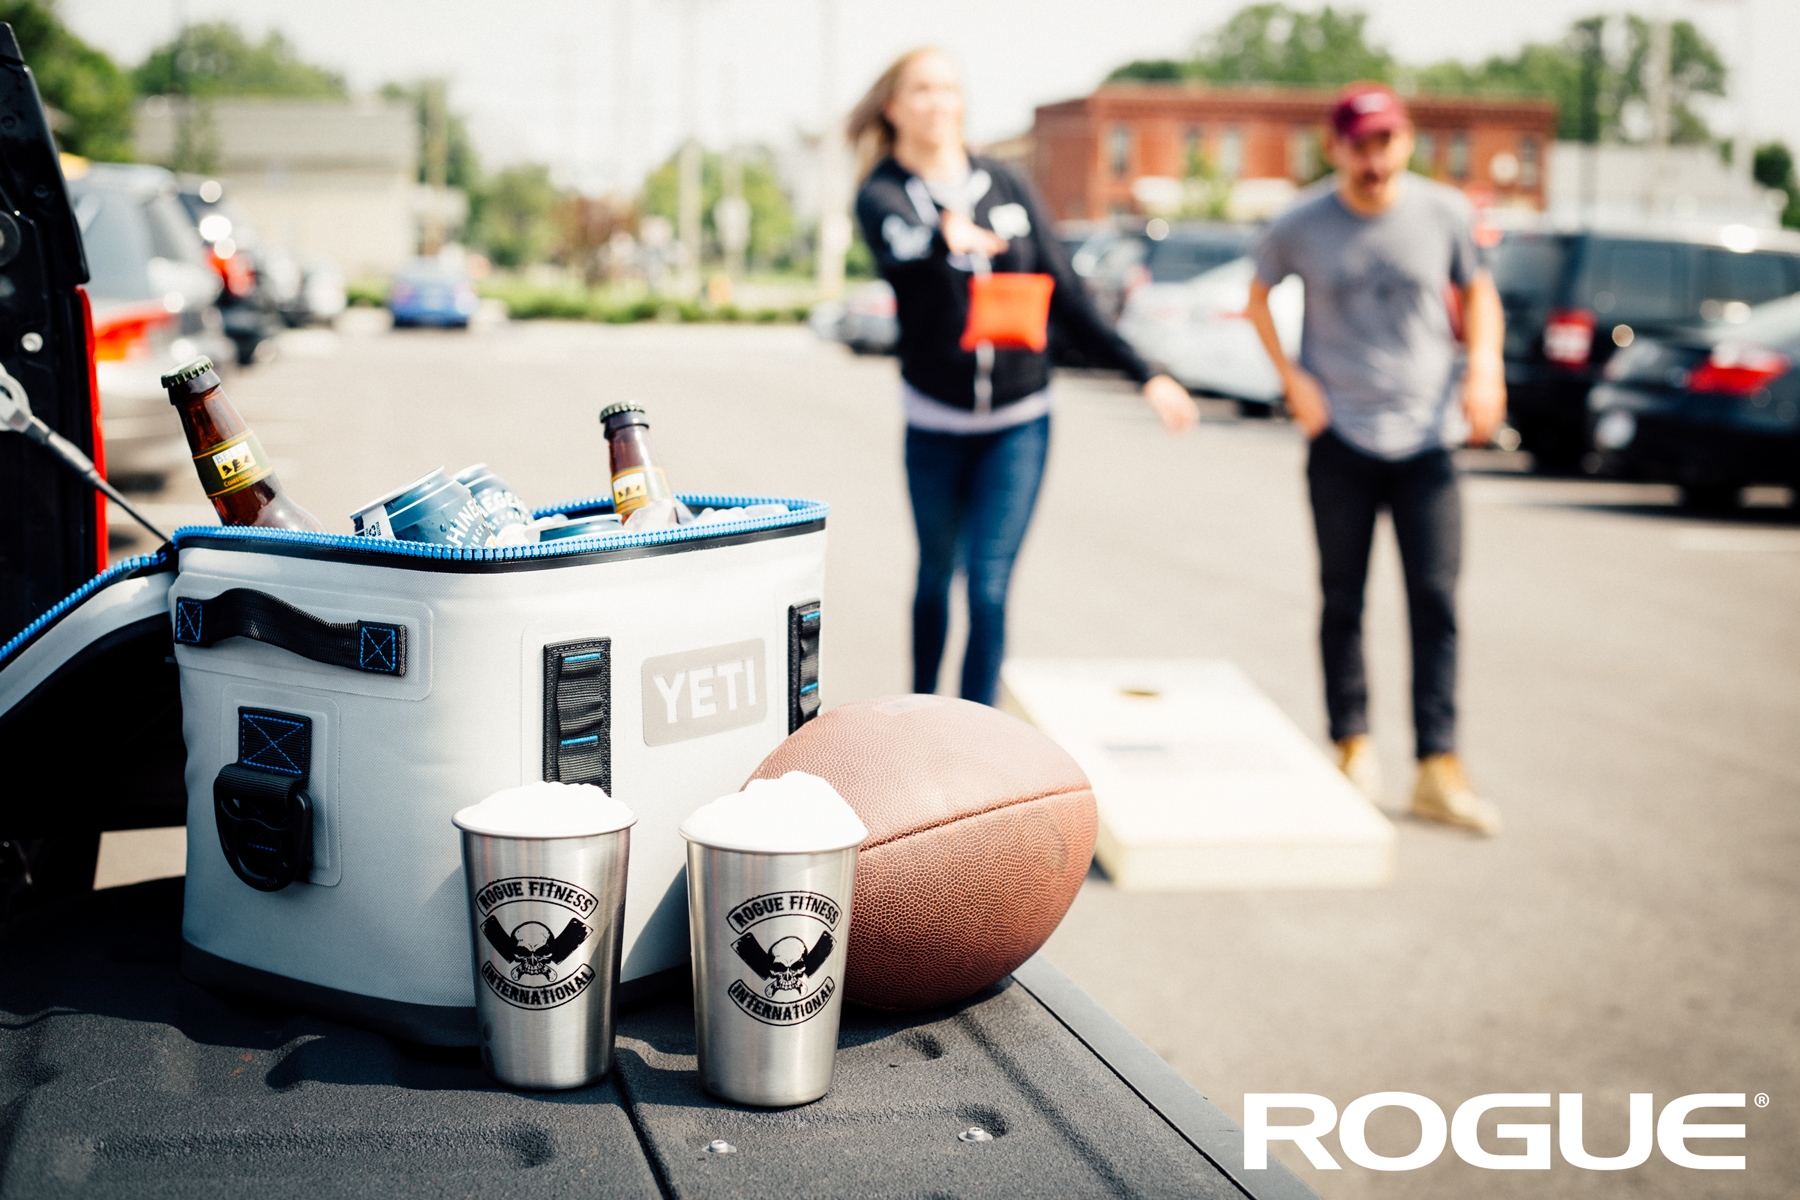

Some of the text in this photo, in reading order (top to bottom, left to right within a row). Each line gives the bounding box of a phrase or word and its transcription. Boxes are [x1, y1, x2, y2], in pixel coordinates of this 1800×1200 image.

[653, 656, 758, 724] YETI
[479, 881, 593, 912] ROGUE FITNESS
[731, 894, 839, 929] ROGUE FITNESS
[484, 965, 593, 1006] INTERNATIONAL
[731, 982, 833, 1021] INTERNATIONAL
